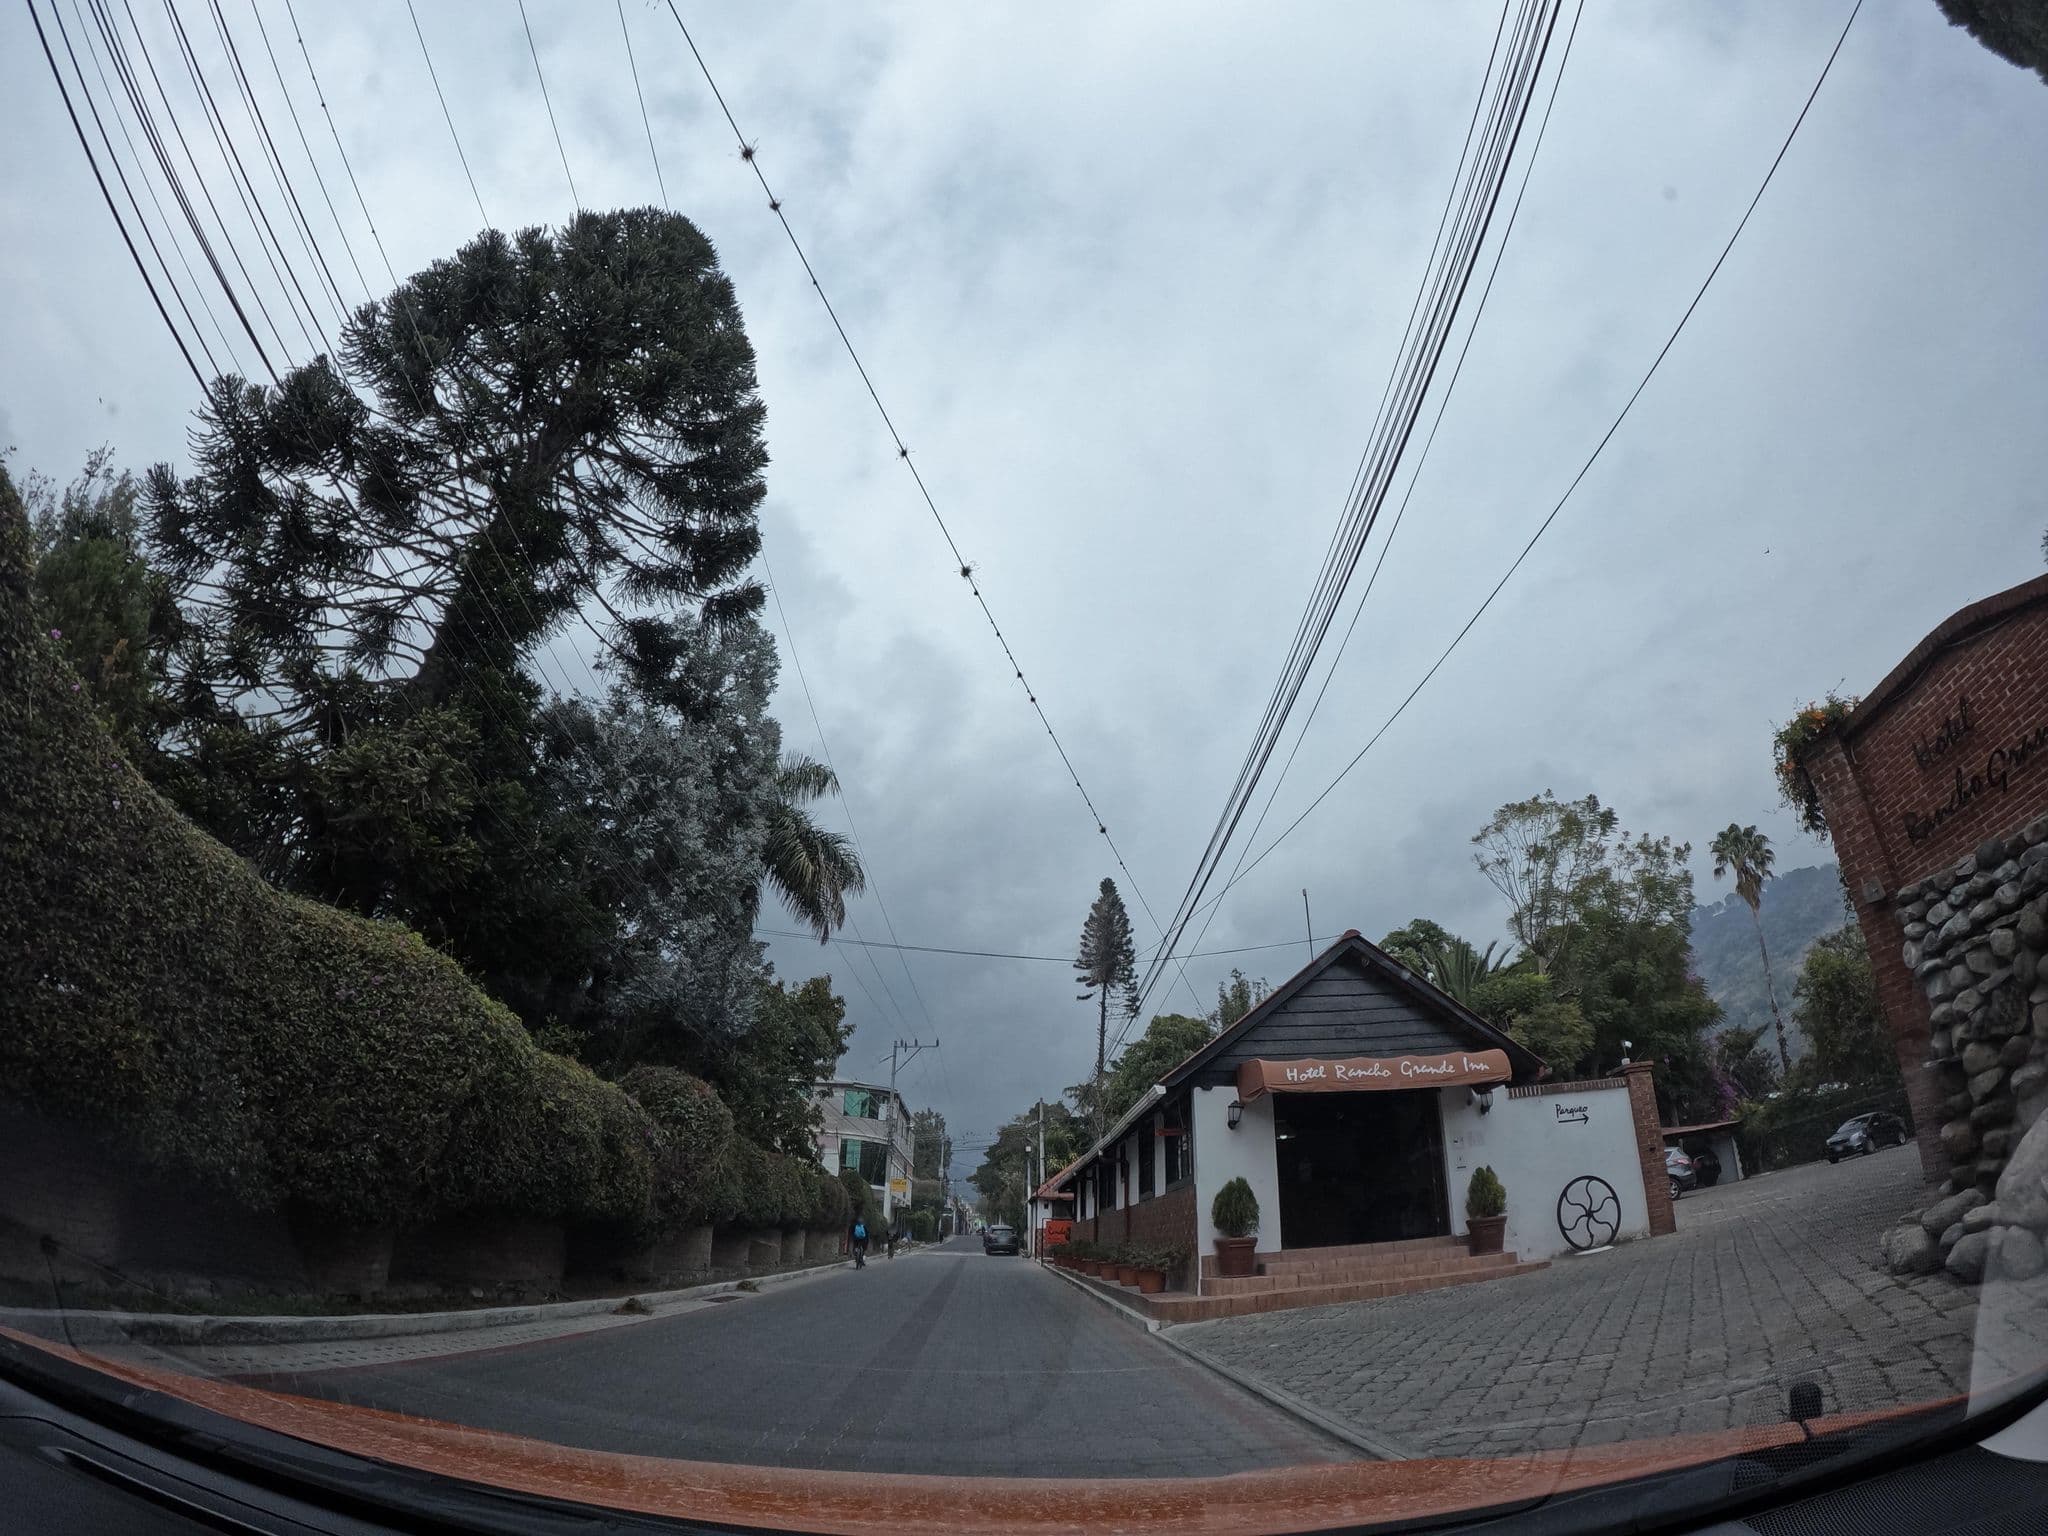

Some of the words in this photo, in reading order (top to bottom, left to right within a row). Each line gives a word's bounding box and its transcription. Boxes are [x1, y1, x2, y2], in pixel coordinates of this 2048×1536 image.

[1912, 696, 1975, 766] Hotel
[1286, 1067, 1327, 1082] Hotel
[1335, 1062, 1391, 1081] Rancho
[1401, 1057, 1456, 1077] Grande
[1463, 1056, 1490, 1073] Inn
[1555, 1103, 1588, 1119] Parqueo
